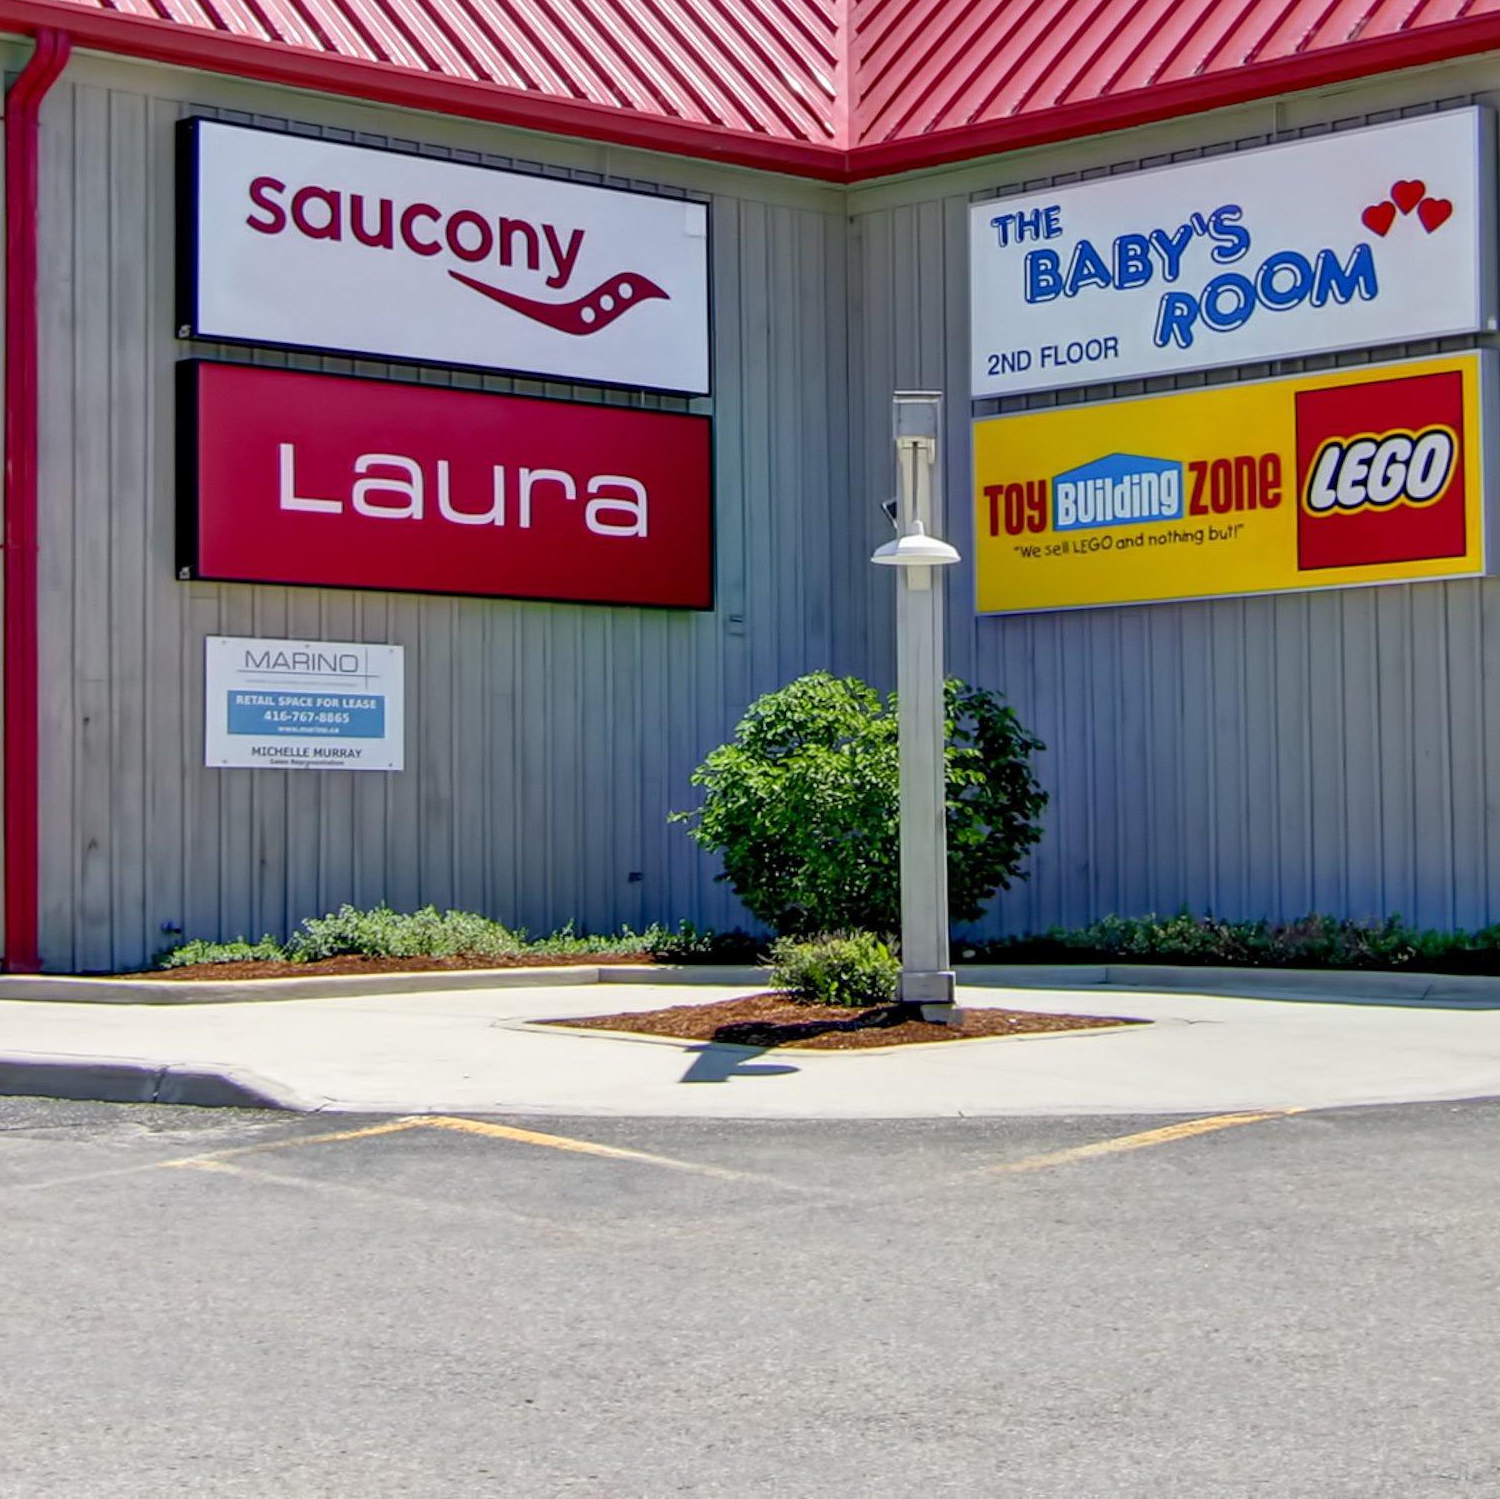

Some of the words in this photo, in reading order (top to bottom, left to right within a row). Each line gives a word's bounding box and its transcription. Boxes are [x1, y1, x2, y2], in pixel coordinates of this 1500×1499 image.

[245, 175, 586, 290] saucony
[990, 204, 1063, 247] THE
[1024, 204, 1251, 304] BABY'S
[1153, 242, 1379, 349] ROOM
[987, 350, 1032, 376] 2ND
[1040, 336, 1120, 368] FLOOR
[278, 442, 649, 538] Laura
[1306, 430, 1455, 513] LEGO
[982, 479, 1048, 537] TOY
[1045, 540, 1070, 556] sell
[1072, 535, 1114, 555] LEGO
[1116, 533, 1144, 550] and
[1148, 525, 1205, 547] nothing
[245, 650, 359, 673] MARINO
[235, 694, 276, 706] RETAIL
[278, 696, 314, 707] SPACE
[316, 697, 340, 708] FOR
[342, 698, 377, 710] LEASE
[251, 746, 310, 758] MICHELLE
[313, 747, 363, 759] MURRAY
